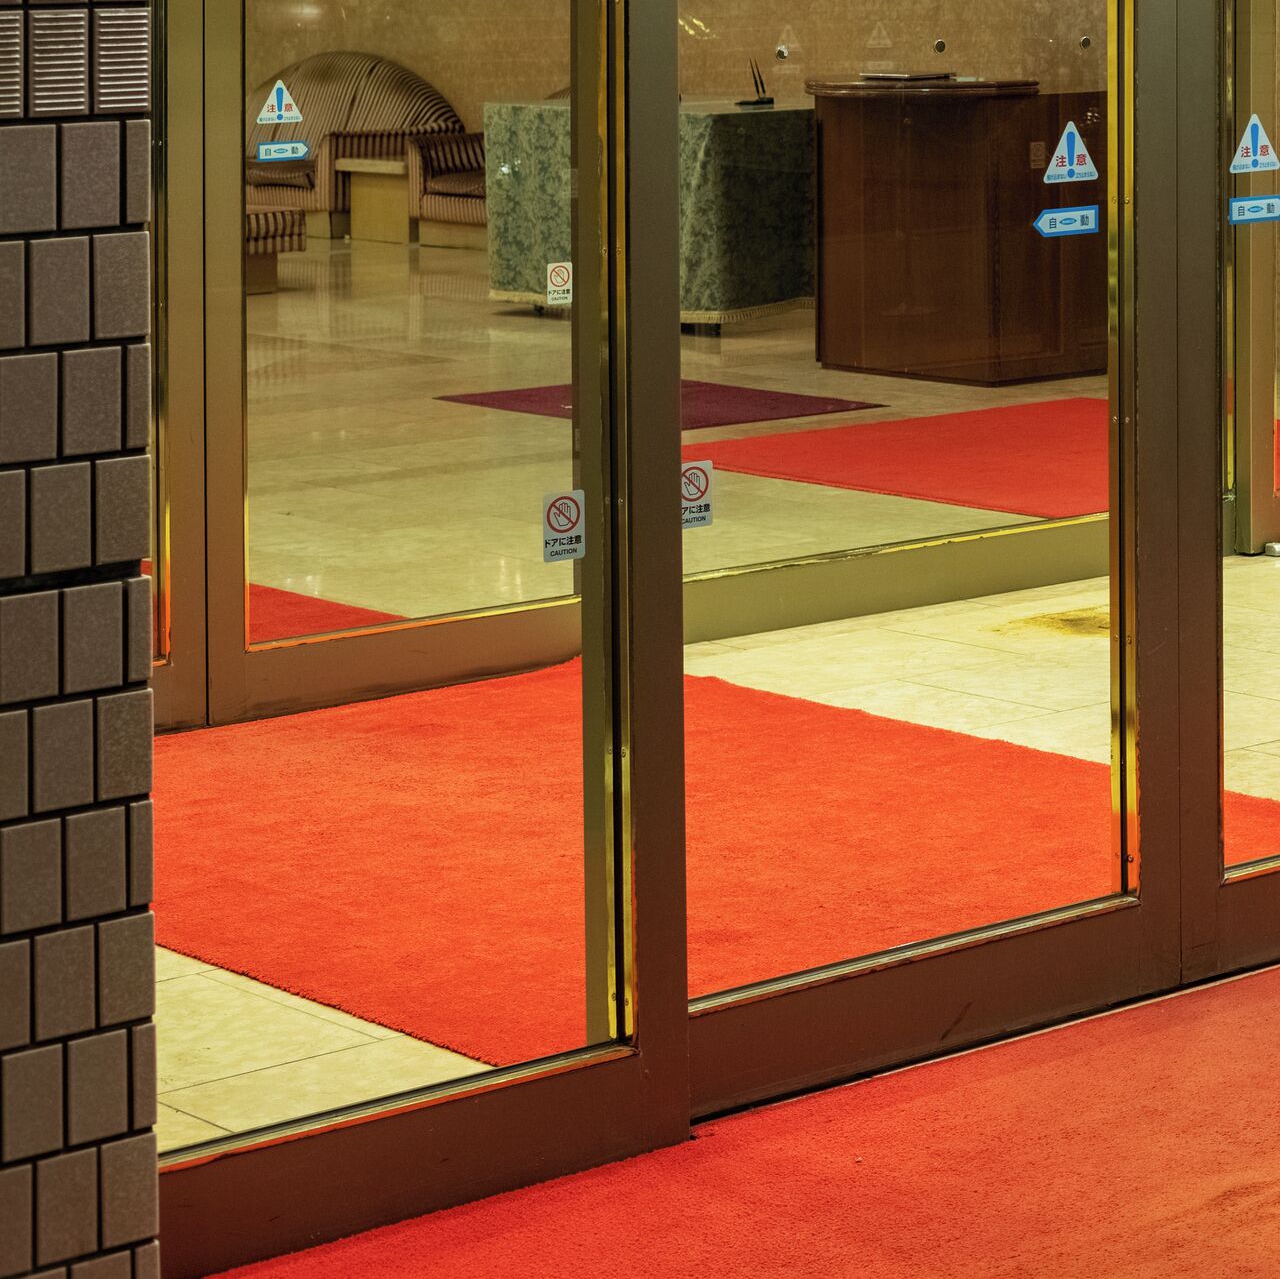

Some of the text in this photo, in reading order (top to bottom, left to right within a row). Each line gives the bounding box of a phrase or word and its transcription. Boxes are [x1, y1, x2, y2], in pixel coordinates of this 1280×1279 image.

[682, 503, 711, 516] アに注意
[545, 534, 582, 548] ドアに注意
[550, 547, 577, 557] CAUTION
